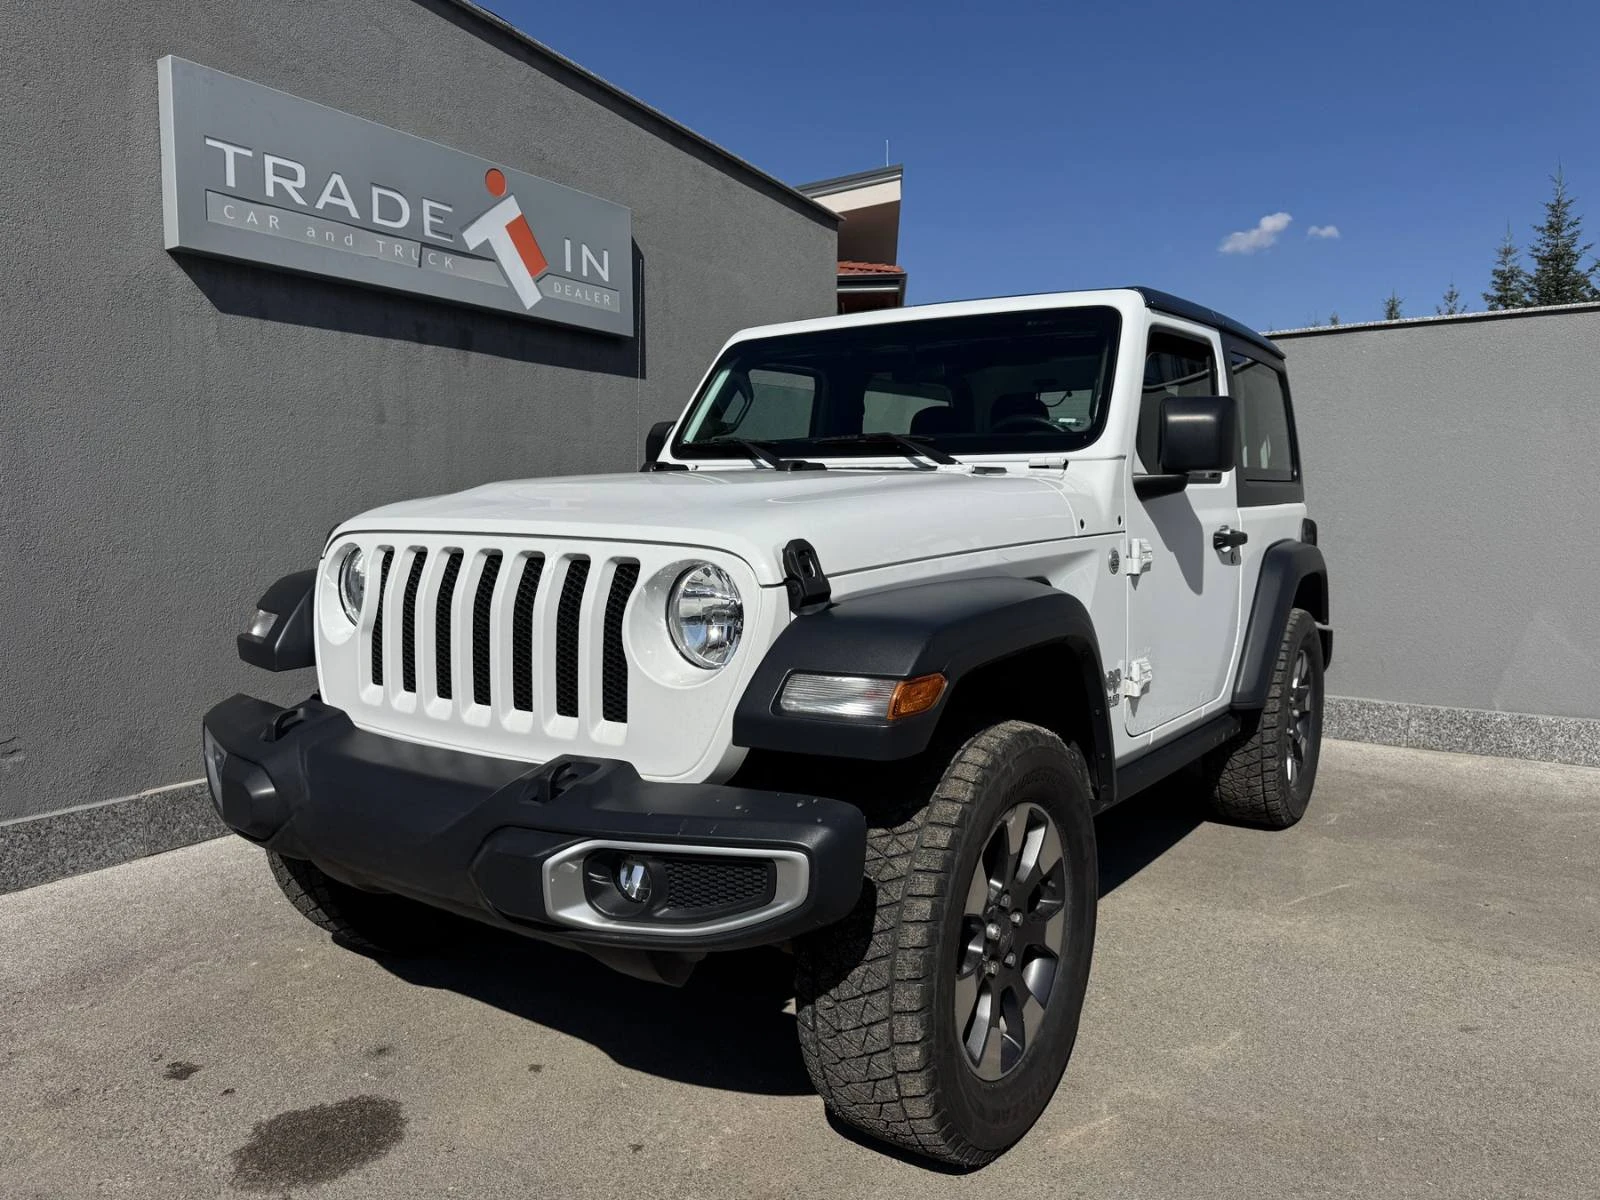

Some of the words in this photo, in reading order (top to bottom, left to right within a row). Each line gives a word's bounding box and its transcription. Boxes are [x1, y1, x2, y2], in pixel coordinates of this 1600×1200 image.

[205, 137, 455, 242] TRADE
[563, 238, 609, 282] IN
[223, 204, 280, 230] CAR
[306, 225, 354, 247] and
[376, 239, 455, 271] TRUCK
[554, 281, 611, 305] DEALER
